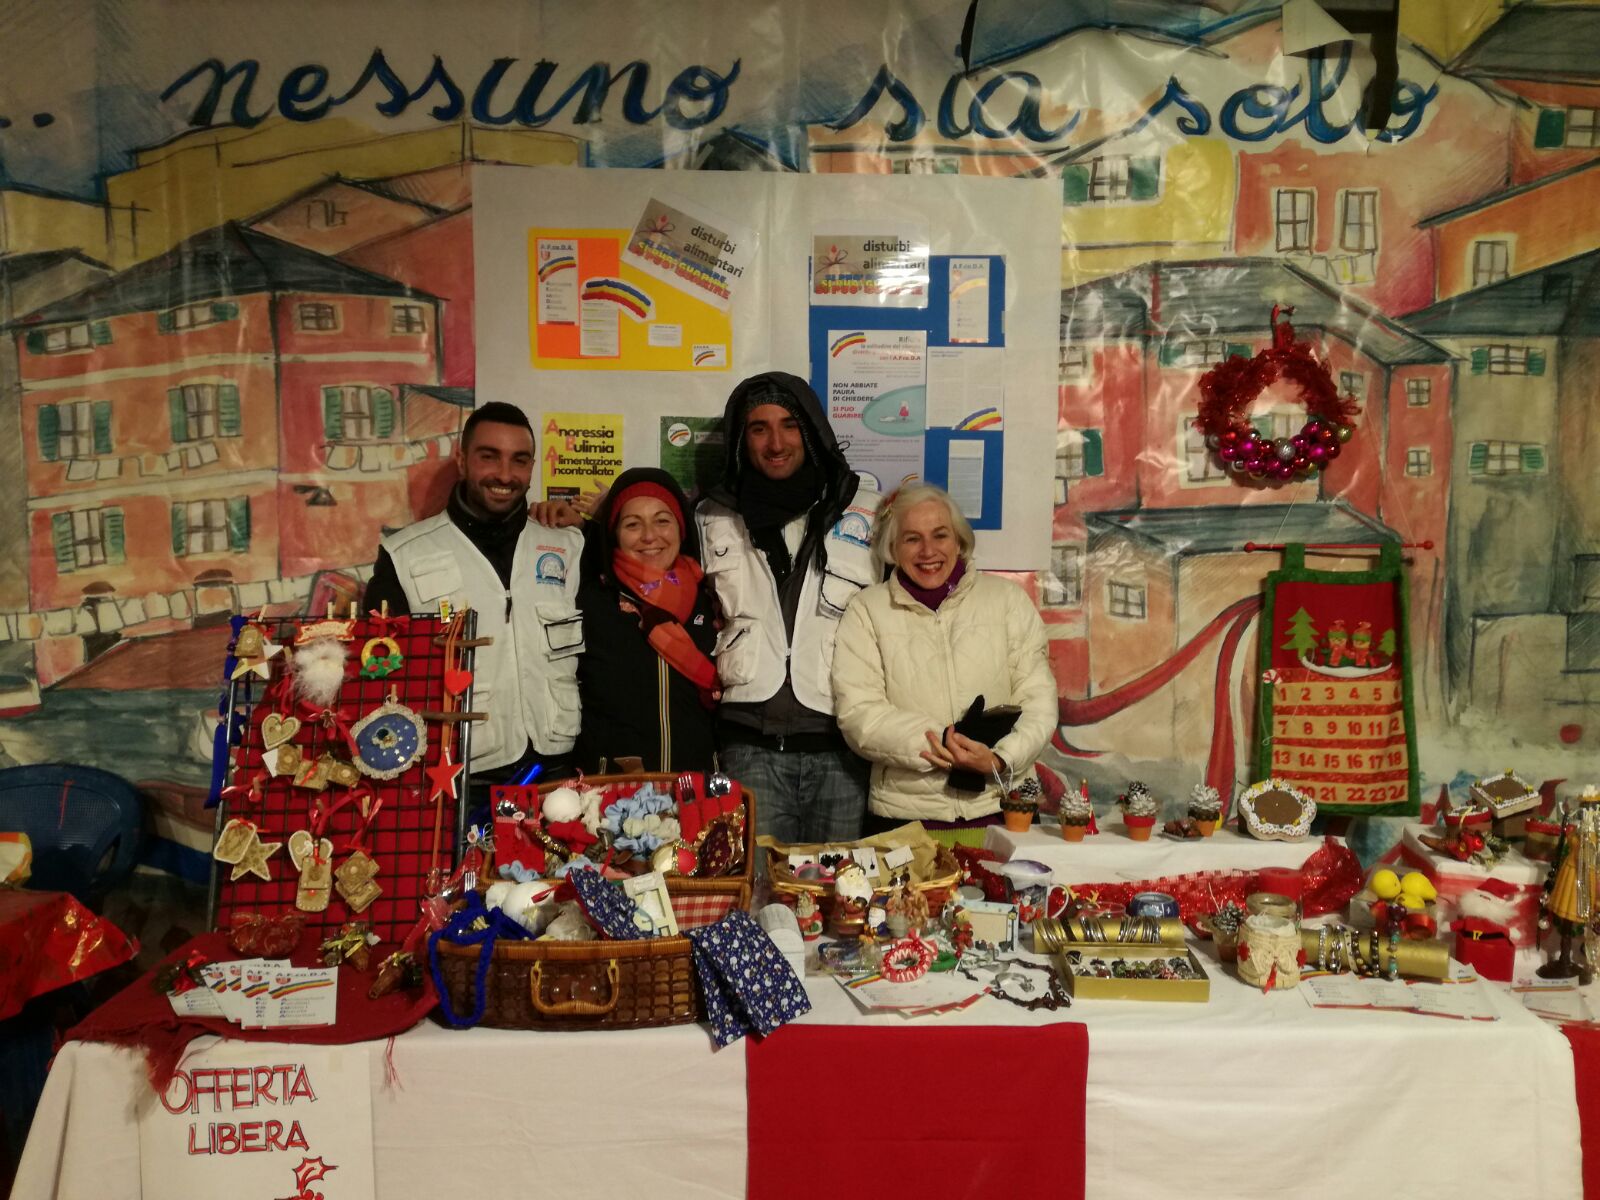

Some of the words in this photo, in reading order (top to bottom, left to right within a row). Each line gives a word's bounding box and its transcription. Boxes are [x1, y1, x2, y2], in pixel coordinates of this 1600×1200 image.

[162, 47, 741, 129] nessuno
[831, 64, 1080, 142] sia
[1128, 40, 1439, 144] solo
[691, 225, 737, 254] disturbi
[863, 240, 910, 252] disturbi
[683, 242, 744, 278] alimentari
[545, 419, 614, 438] Anoressia
[565, 435, 614, 453] Bulimia
[544, 446, 622, 466] Alimentazione
[550, 457, 614, 478] Incontrollata
[1280, 688, 1287, 701] 1
[1301, 688, 1311, 701] 2
[1325, 687, 1335, 700] 3
[1349, 687, 1360, 700] 4
[1373, 688, 1382, 701] 5
[1277, 721, 1288, 735] 7
[1303, 722, 1313, 735] 8
[1327, 722, 1337, 735] 9
[1347, 722, 1362, 736] 10
[1369, 721, 1383, 736] 11
[1389, 717, 1400, 735] 12
[1274, 751, 1291, 765] 13
[1300, 752, 1315, 767] 14
[1324, 753, 1340, 769] 15
[1347, 753, 1362, 769] 16
[1368, 754, 1384, 769] 17
[1387, 751, 1402, 767] 18
[1320, 786, 1336, 801] 21
[1347, 788, 1366, 802] 22
[1369, 787, 1386, 801] 23
[1387, 785, 1405, 800] 24
[160, 1063, 318, 1115] OFFERTA
[188, 1119, 310, 1155] LIBERA
